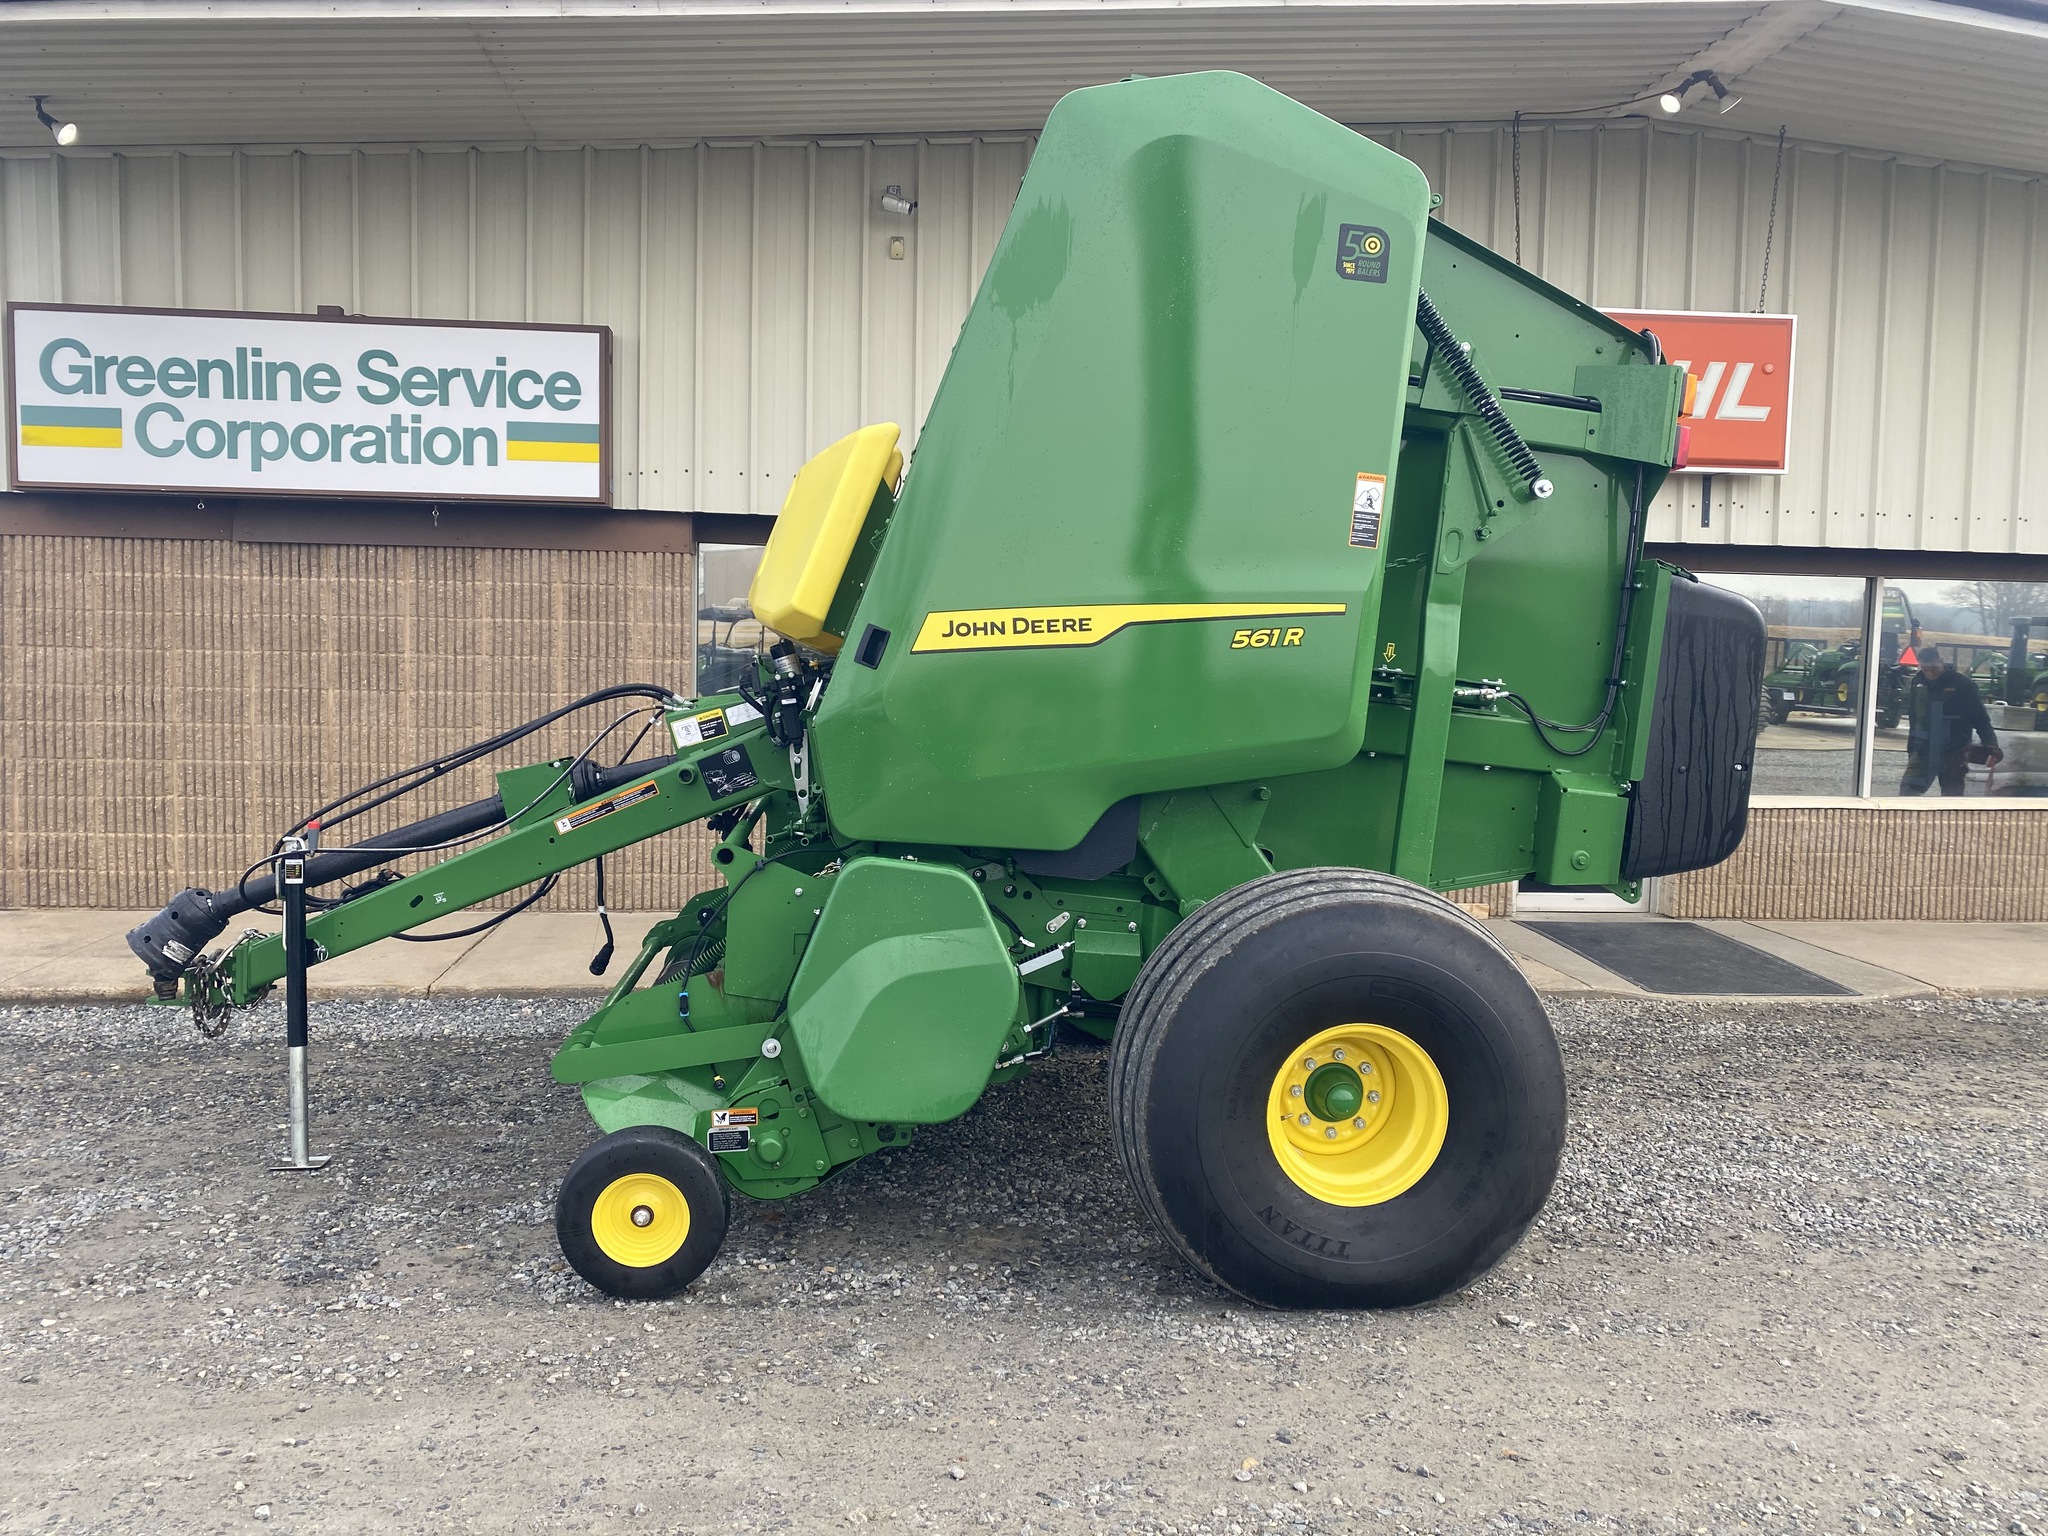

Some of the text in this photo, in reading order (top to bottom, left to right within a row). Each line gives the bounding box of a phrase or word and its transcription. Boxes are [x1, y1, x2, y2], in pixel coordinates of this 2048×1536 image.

[1342, 261, 1356, 269] SINCE
[1357, 260, 1381, 269] ROUND
[1357, 267, 1381, 278] BALERS
[38, 337, 582, 412] Greenline Service
[134, 402, 498, 472] Corporation
[941, 617, 1093, 638] JOHN DEERE
[1255, 1204, 1351, 1261] TITAN
